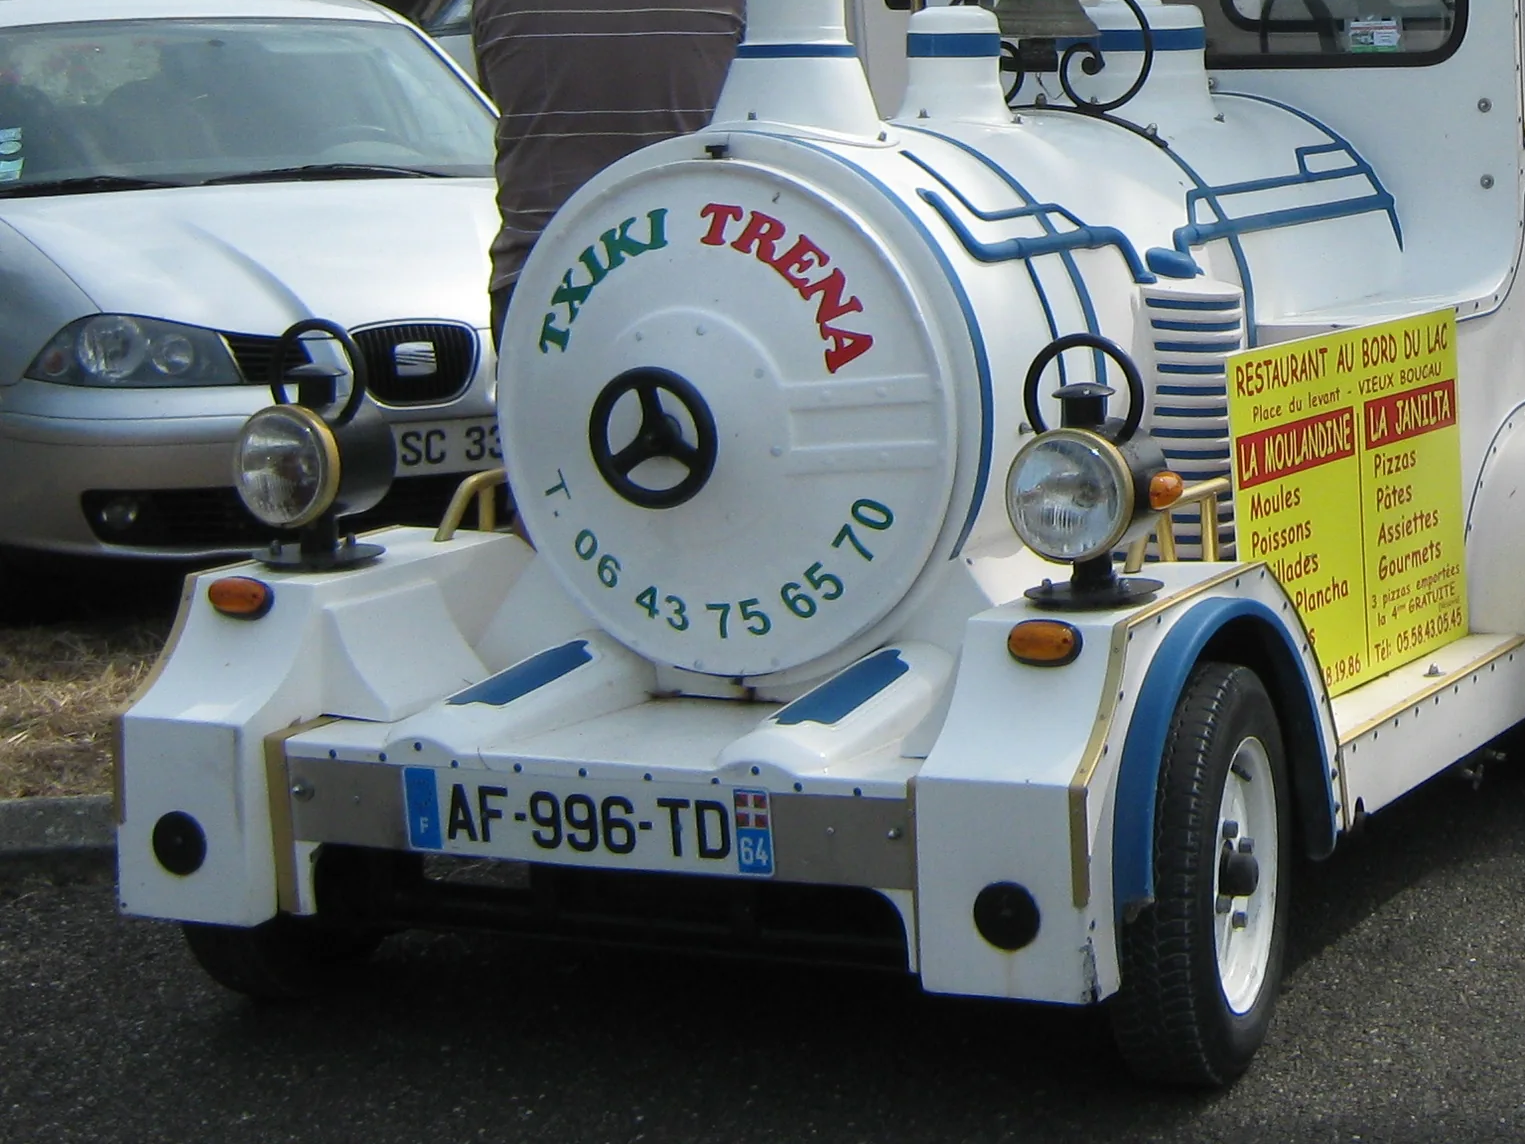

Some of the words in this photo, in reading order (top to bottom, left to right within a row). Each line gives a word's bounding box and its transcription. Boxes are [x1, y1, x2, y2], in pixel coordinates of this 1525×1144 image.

[539, 208, 669, 354] TXIKI
[699, 203, 874, 374] TRENA
[1235, 347, 1328, 398] RESTAURANT
[1336, 343, 1354, 372] AU
[1362, 333, 1397, 369] BORD
[1404, 329, 1422, 360] DU
[1426, 323, 1448, 352] LAC
[1252, 403, 1282, 423] Place
[1289, 398, 1303, 413] du
[1308, 389, 1341, 410] levant
[1358, 376, 1395, 396] VIEUX
[1400, 362, 1442, 386] BOUCAU
[1368, 410, 1389, 443] LA
[1394, 389, 1451, 435] JANILTA
[401, 431, 446, 465] SC
[1239, 447, 1261, 482] LA
[1264, 413, 1352, 476] MOULANDINE
[1374, 448, 1417, 478] Pizzas
[1250, 486, 1301, 522] Moules
[1376, 483, 1413, 513] Pâtes
[1251, 518, 1312, 558] Poissons
[1377, 507, 1439, 548] Assiettes
[574, 528, 624, 589] 06
[635, 585, 690, 632] 43
[705, 598, 772, 639] 75
[780, 561, 845, 619] 65
[831, 498, 895, 562] 70
[1378, 538, 1442, 581] Gourmets
[1296, 576, 1349, 613] Plancha
[1371, 594, 1377, 609] 3
[1382, 584, 1411, 609] pizzas
[1416, 563, 1460, 590] emportées
[1377, 613, 1386, 627] la
[1408, 581, 1456, 614] GRATUITE
[1374, 638, 1392, 663] Tél:
[1396, 607, 1462, 654] 05.58.43.05.45
[420, 818, 429, 835] F
[447, 783, 732, 860] AF-996-TD
[739, 836, 769, 866] 64
